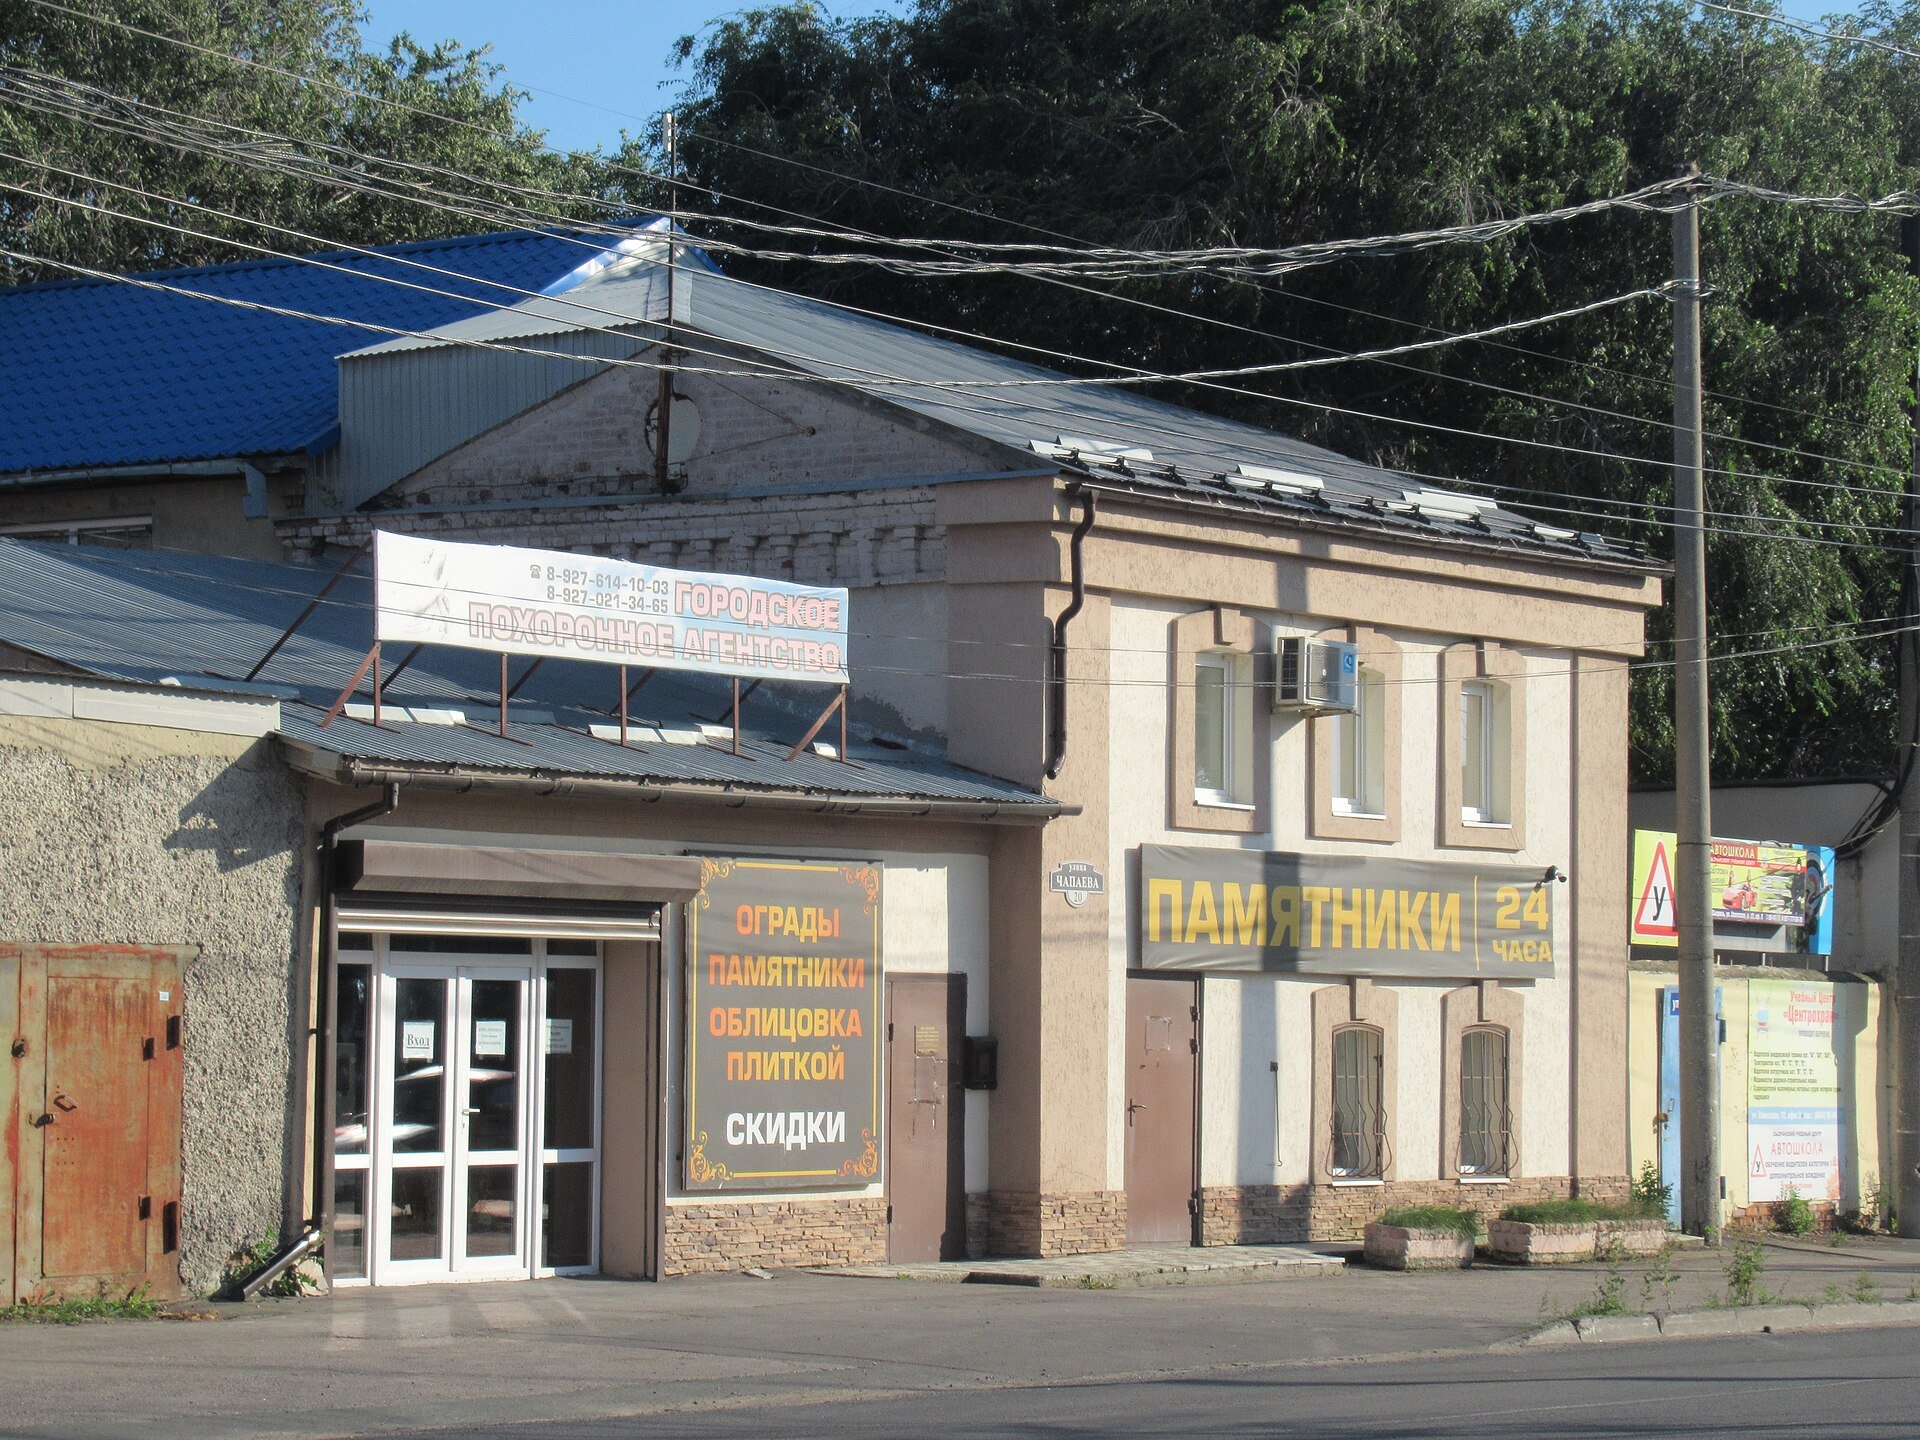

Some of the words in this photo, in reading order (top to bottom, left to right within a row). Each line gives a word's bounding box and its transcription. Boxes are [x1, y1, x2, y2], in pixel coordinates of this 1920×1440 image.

[546, 567, 669, 596] 8-927-614-10-03
[546, 585, 669, 614] 8-927-021-34-65
[674, 581, 840, 630] ГОРОДСКОЕ
[468, 602, 675, 657] ПОХОРОННОЕ
[683, 629, 840, 673] АГЕНТСТВО
[1710, 844, 1755, 858] АВТОШКОЛА
[1056, 875, 1099, 888] ЧАПАЕВА
[736, 904, 839, 942] ОГРАДЫ
[1148, 878, 1461, 952] ПАМЯТНИКИ
[1496, 886, 1549, 930] 24
[1492, 940, 1553, 963] ЧАСА
[708, 955, 864, 988] ПАМЯТНИКИ
[407, 1033, 430, 1047] Вход
[709, 1007, 862, 1043] ОБЛИЦОВКА
[727, 1044, 844, 1081] ПЛИТКОЙ
[726, 1111, 845, 1150] СКИДКИ
[1771, 1142, 1823, 1155] АВТОШКОЛА
